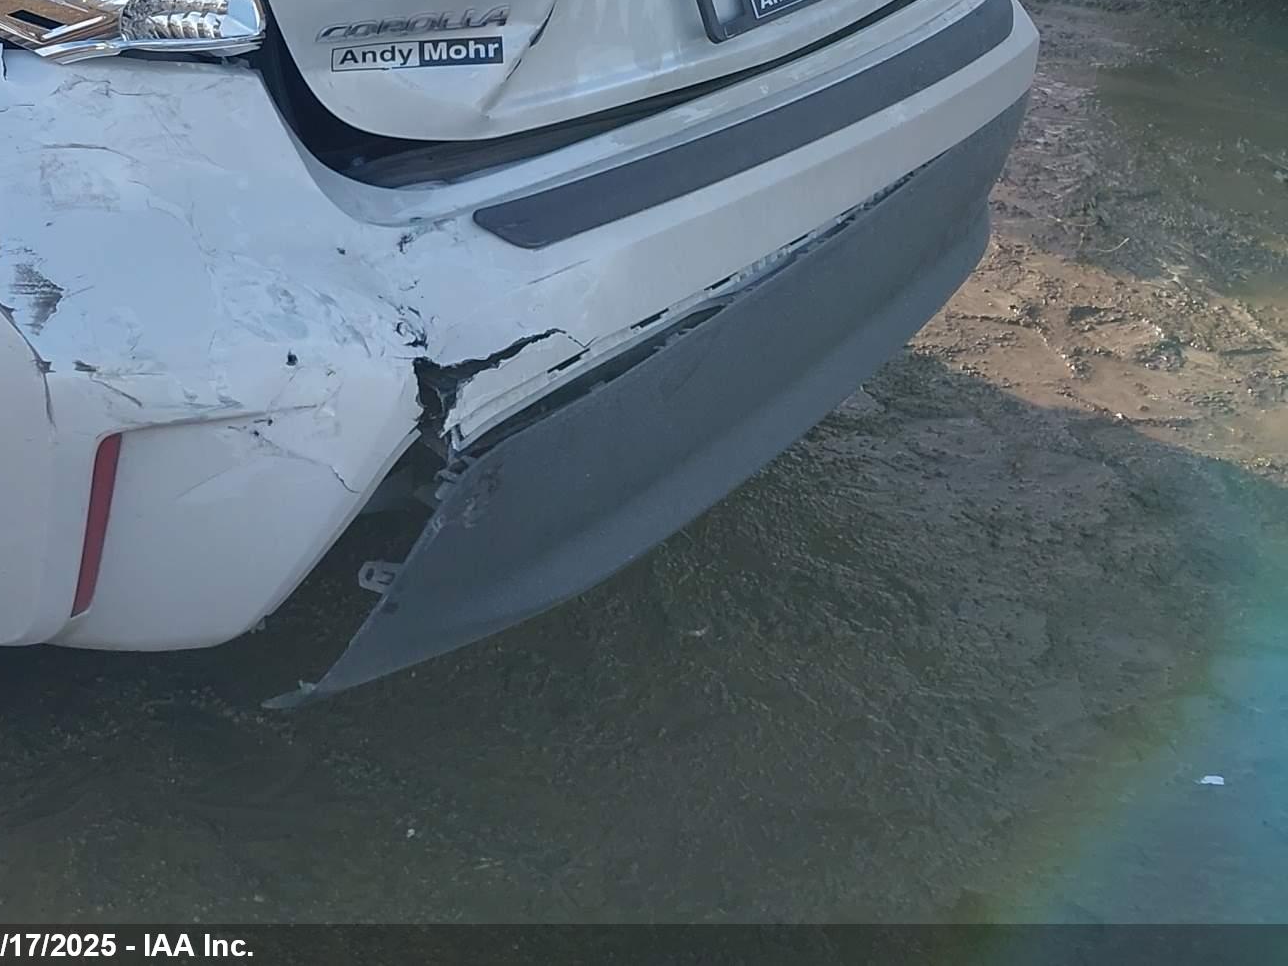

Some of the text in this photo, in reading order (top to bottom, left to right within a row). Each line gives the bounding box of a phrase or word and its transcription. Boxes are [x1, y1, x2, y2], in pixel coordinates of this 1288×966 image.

[317, 5, 510, 41] COROLLA
[338, 40, 499, 66] Andy Mohr
